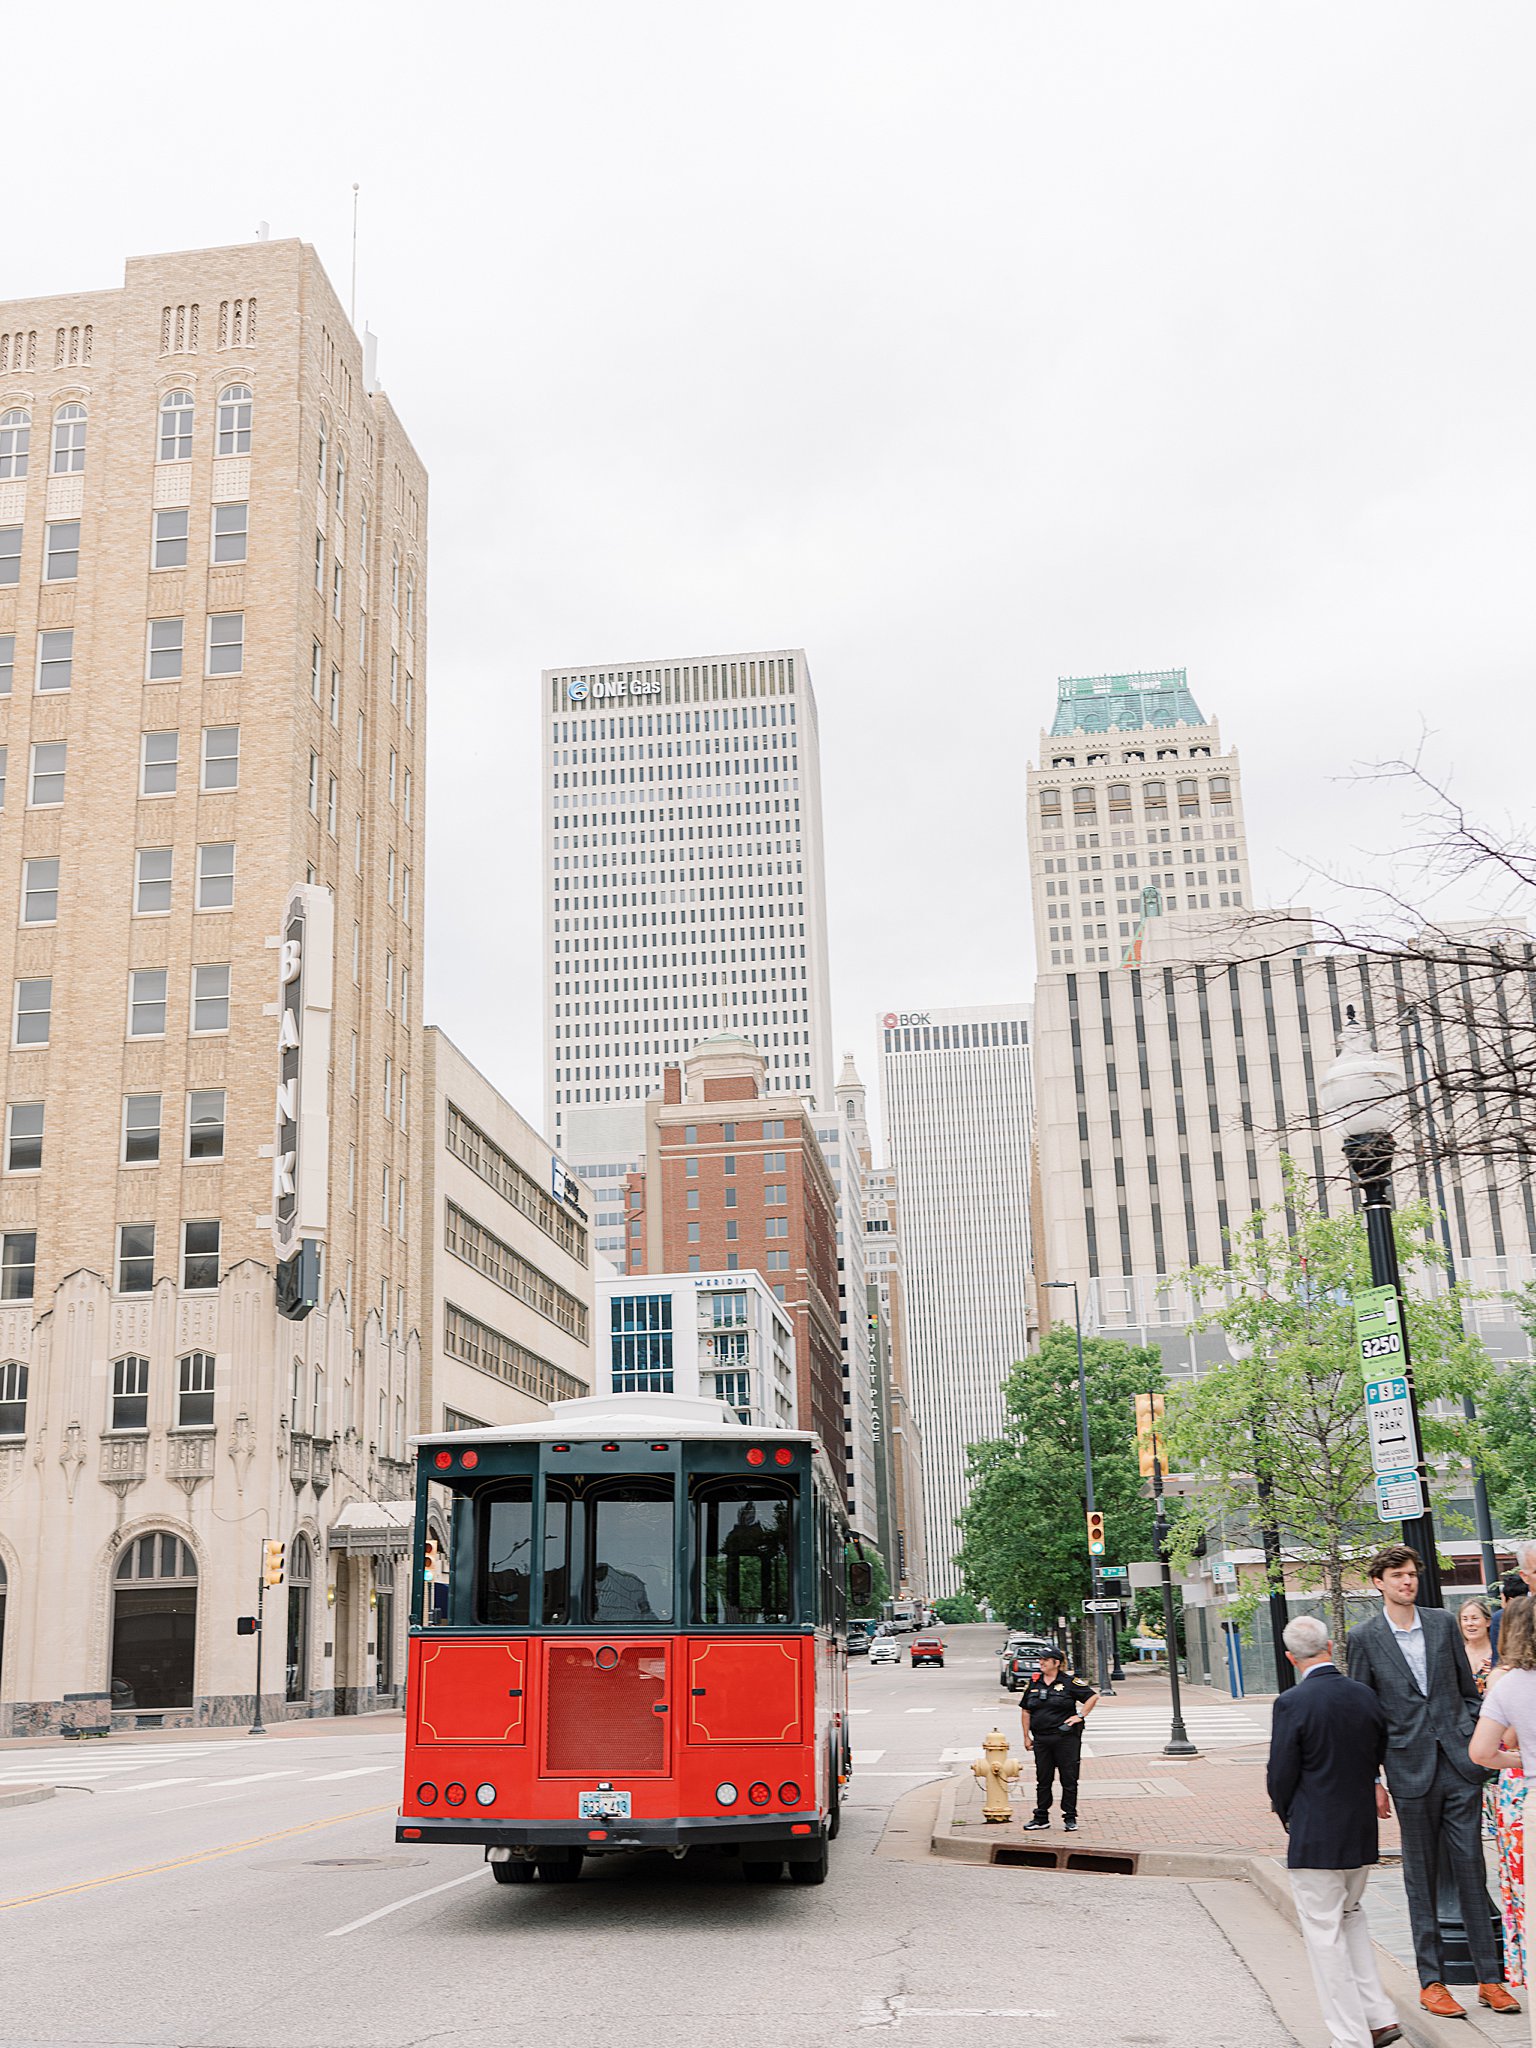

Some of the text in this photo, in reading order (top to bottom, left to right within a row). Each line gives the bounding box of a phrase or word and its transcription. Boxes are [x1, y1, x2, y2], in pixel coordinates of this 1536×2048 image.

[592, 679, 661, 698] ONE Gas
[900, 1013, 931, 1026] BOK
[275, 939, 302, 1198] BANK
[695, 1278, 747, 1286] MERIDIA
[1362, 1334, 1400, 1358] 3250
[866, 1333, 880, 1442] HYATT PLACE
[1374, 1406, 1404, 1420] PAY TO
[1378, 1420, 1402, 1432] PARK
